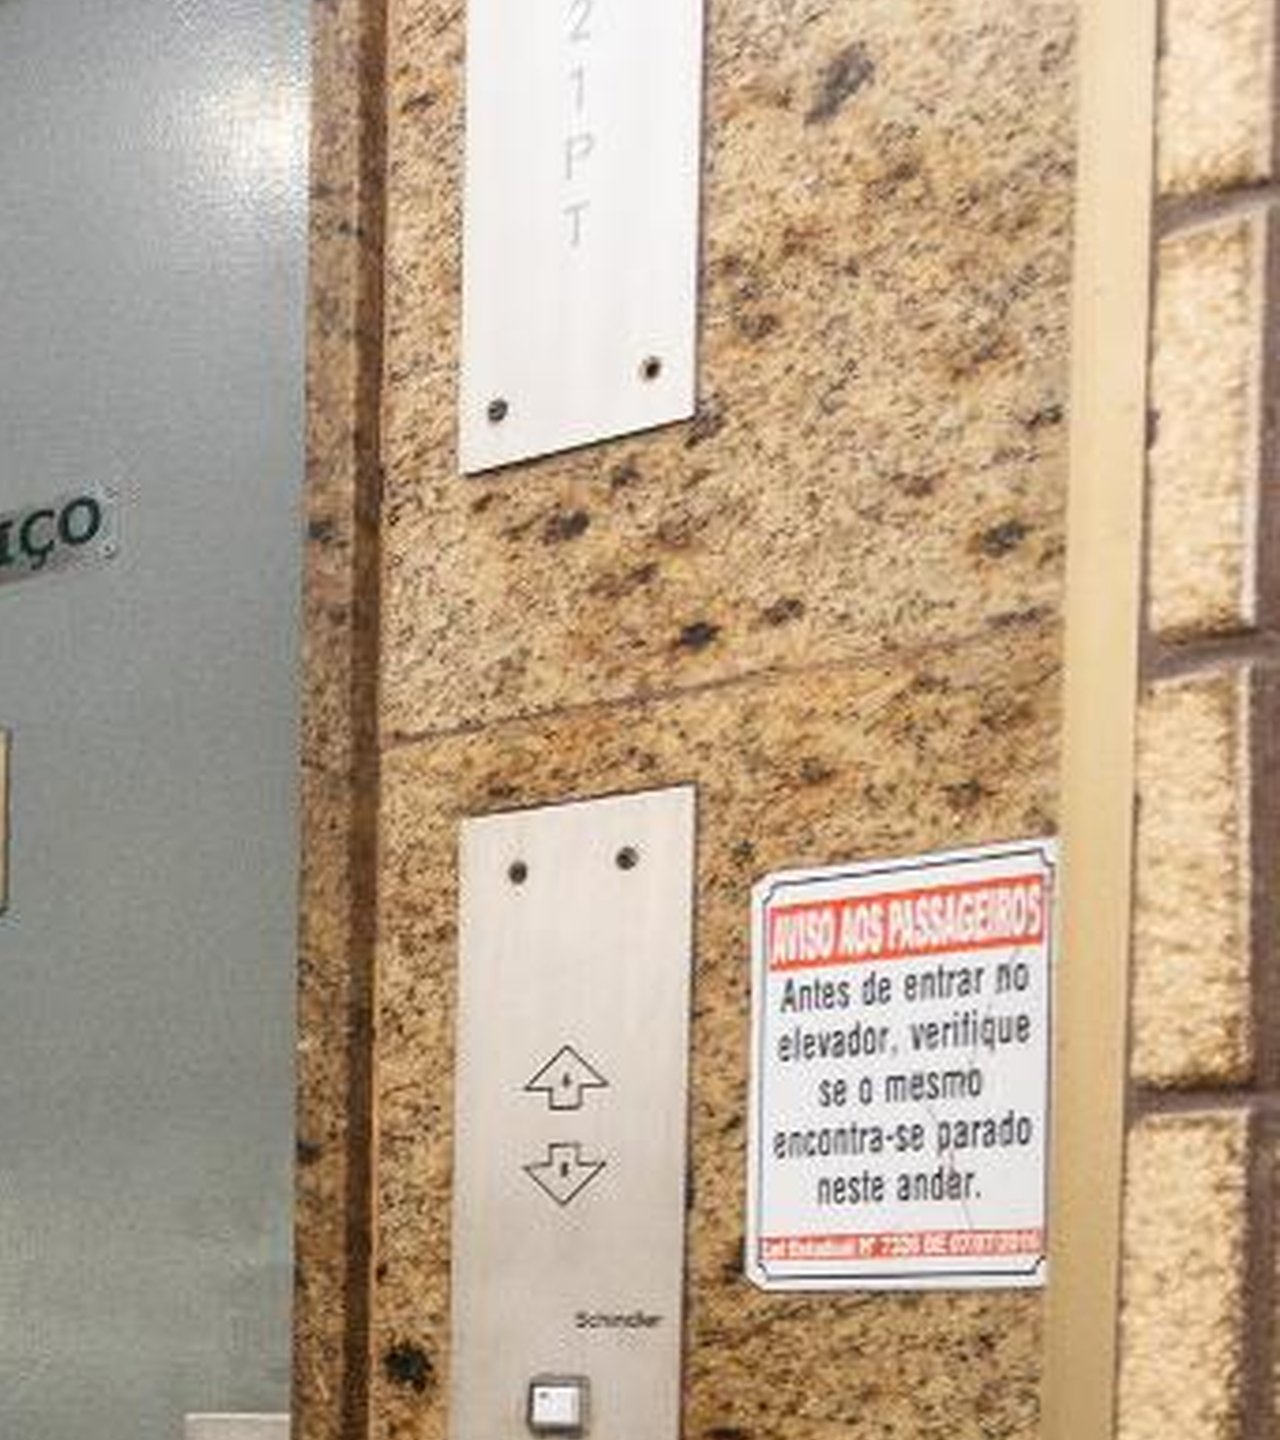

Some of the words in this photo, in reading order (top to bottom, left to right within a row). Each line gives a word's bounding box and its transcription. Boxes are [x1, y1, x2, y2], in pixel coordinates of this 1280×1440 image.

[570, 63, 583, 110] 1
[565, 132, 594, 180] P
[562, 198, 591, 248] T
[774, 908, 836, 962] AVISO
[839, 900, 885, 956] AOS
[889, 883, 1041, 950] PASSAGEIROS
[780, 977, 851, 1013] Antes
[862, 970, 892, 1007] de
[903, 962, 985, 1002] entrar
[994, 962, 1031, 995] no
[909, 1009, 1033, 1054] verifique
[817, 1078, 848, 1108] se
[858, 1075, 874, 1106] o
[884, 1068, 983, 1103] mesmo
[773, 1122, 925, 1160] encontra-se
[936, 1109, 1034, 1159] parado
[817, 1169, 885, 1205] neste
[896, 1165, 982, 1203] andar.
[574, 1309, 664, 1329] Schindler
